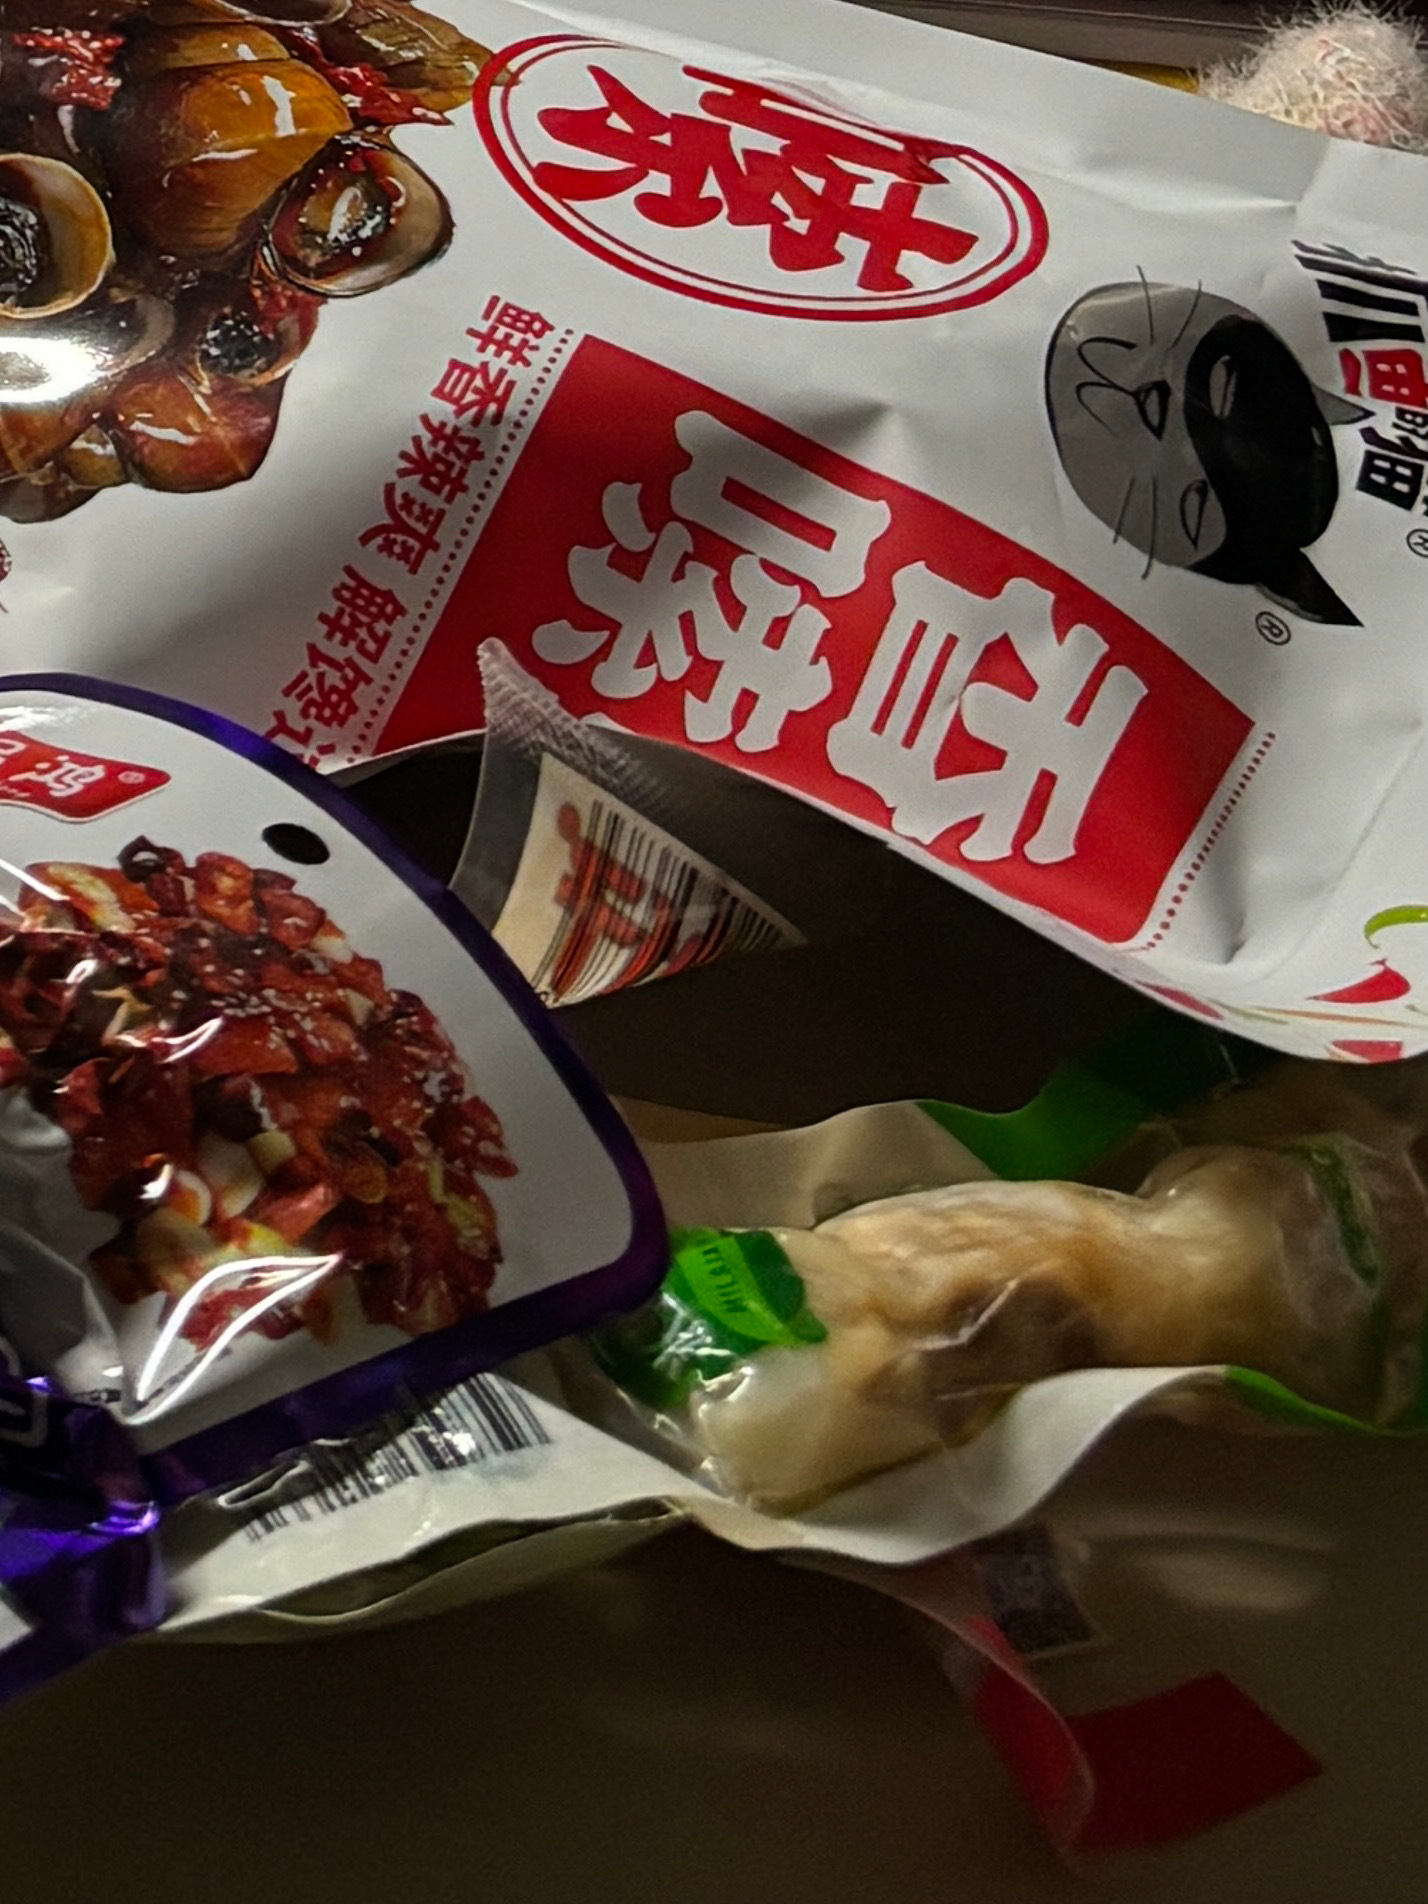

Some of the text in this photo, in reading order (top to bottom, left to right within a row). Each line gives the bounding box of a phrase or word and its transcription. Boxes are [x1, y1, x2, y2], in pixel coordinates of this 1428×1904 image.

[530, 64, 980, 293] 嗦
[356, 293, 555, 580] 鲜香辣爽
[533, 406, 1151, 866] 香嗦
